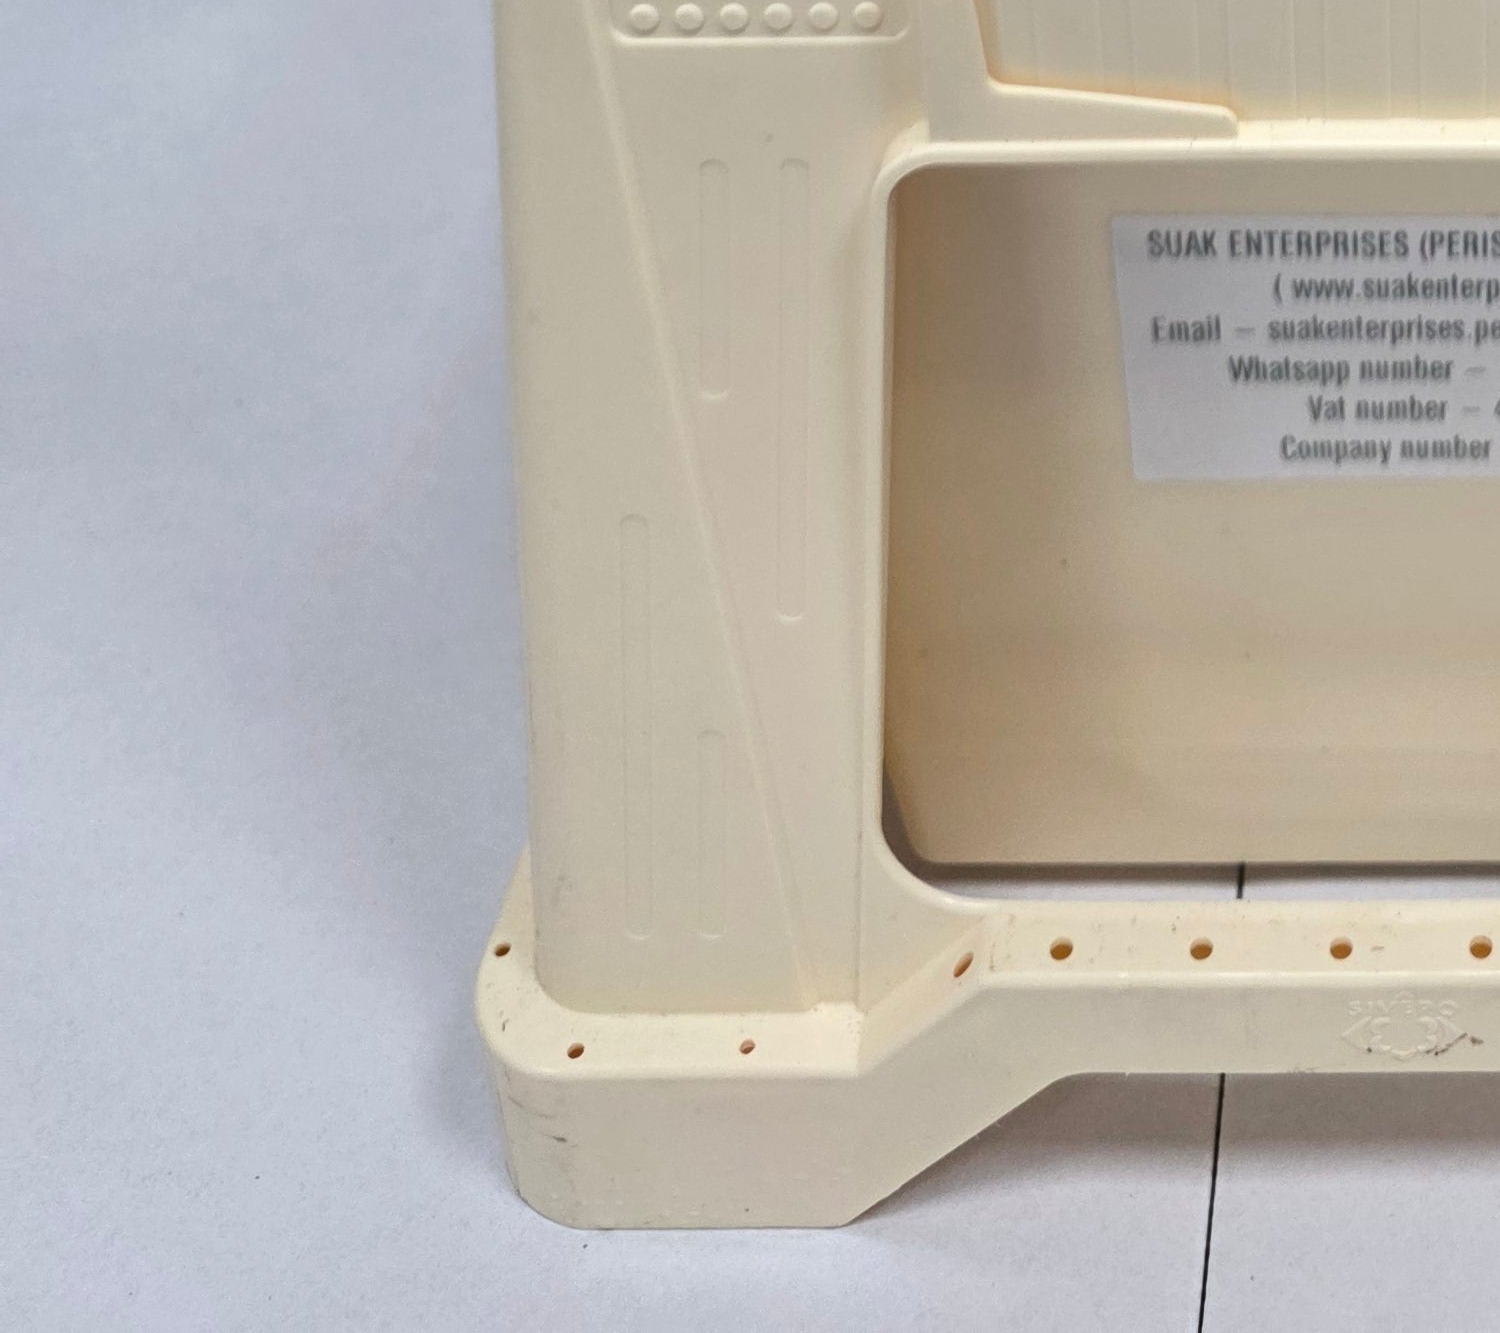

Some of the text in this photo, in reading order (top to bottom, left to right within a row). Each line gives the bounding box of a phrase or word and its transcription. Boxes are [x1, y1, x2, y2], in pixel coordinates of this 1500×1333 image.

[1146, 229, 1217, 260] SUAK
[1228, 229, 1410, 259] ENTERPRISES
[1150, 315, 1222, 344] Email
[1227, 355, 1351, 388] Whatsapp
[1358, 354, 1454, 382] number
[1307, 394, 1346, 424] Vat
[1354, 394, 1448, 423] number
[1279, 434, 1393, 466] Company
[1399, 434, 1491, 461] number
